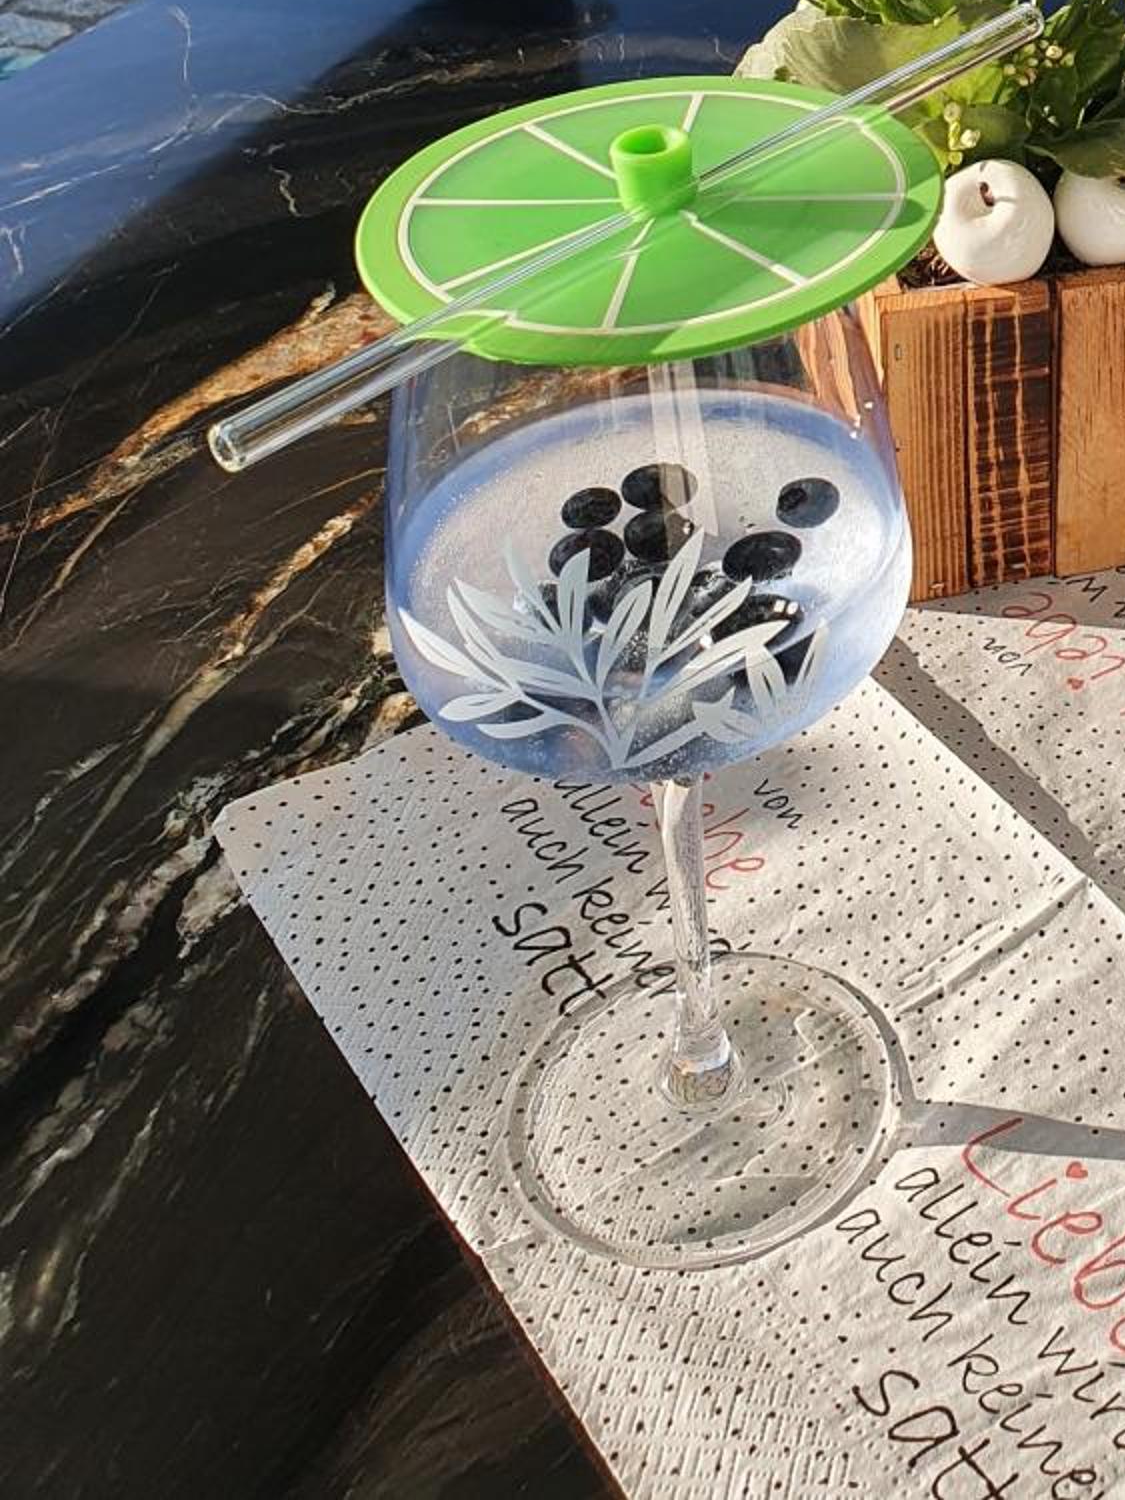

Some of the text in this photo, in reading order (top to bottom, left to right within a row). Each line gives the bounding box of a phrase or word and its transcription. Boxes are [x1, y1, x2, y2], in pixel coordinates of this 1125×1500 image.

[983, 637, 1032, 677] von
[501, 798, 589, 885] auch
[754, 779, 803, 829] von
[894, 1166, 1030, 1326] allein
[835, 1208, 1104, 1500] auch keine
[852, 1369, 1020, 1500] sat
